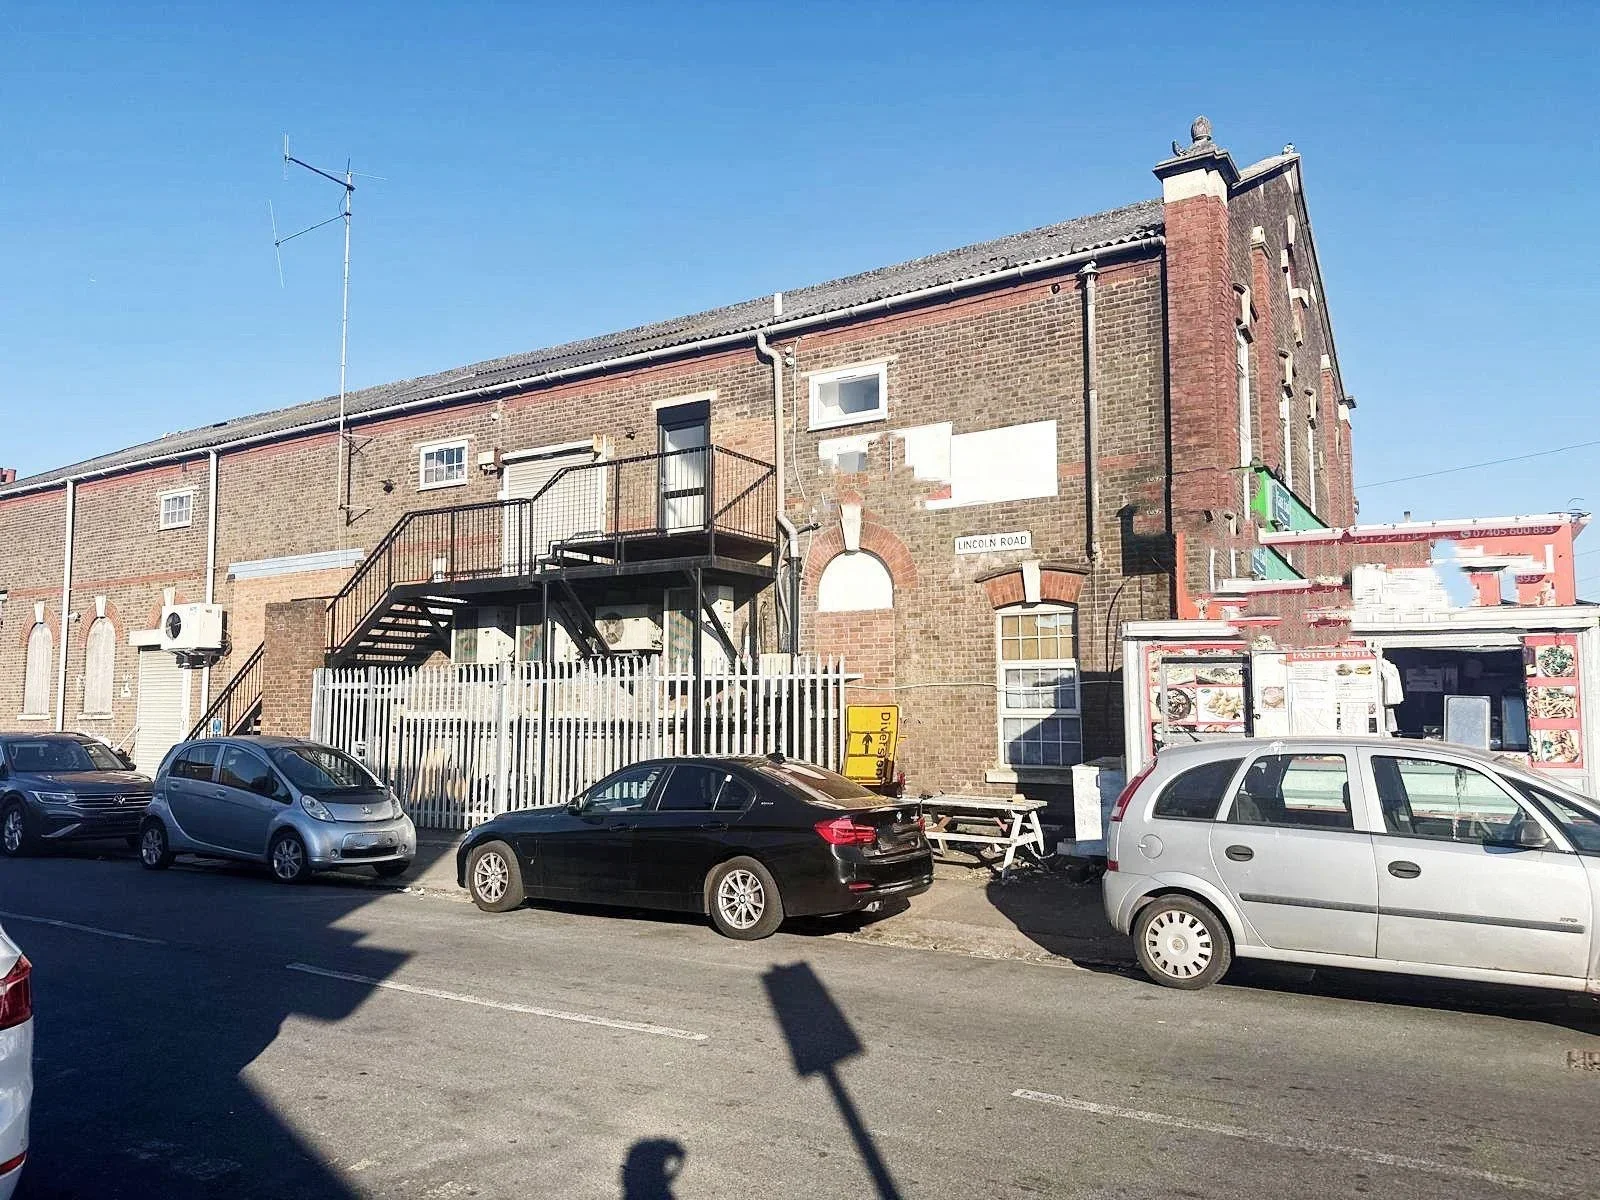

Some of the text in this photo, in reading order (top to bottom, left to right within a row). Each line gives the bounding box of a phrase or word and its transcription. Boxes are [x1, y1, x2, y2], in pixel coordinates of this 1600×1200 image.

[1473, 526, 1554, 538] 07405 600 893
[958, 536, 1027, 550] LINCOLN ROAD
[1293, 651, 1324, 659] TASTE
[875, 712, 891, 779] Diversion
